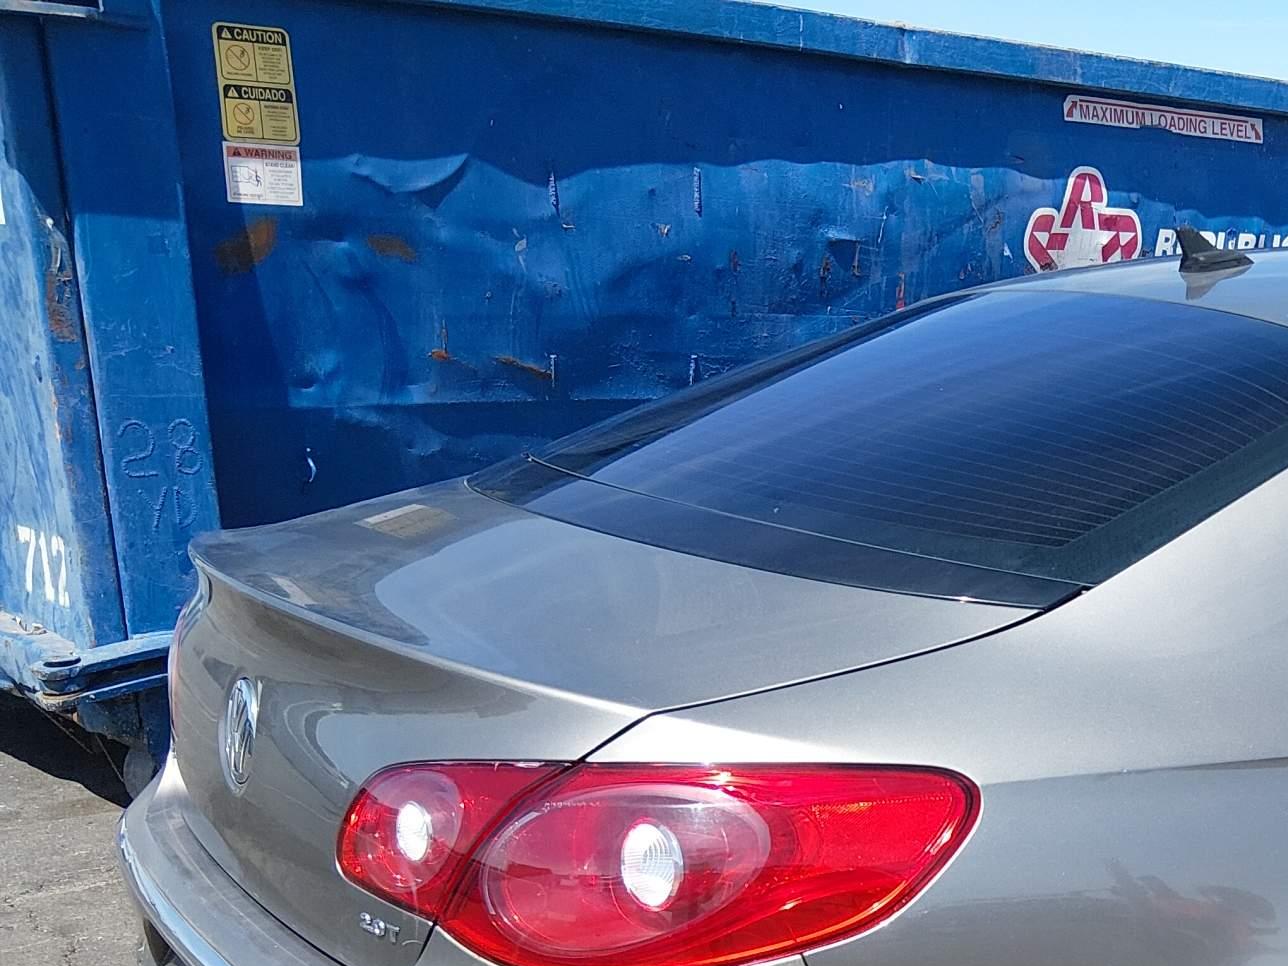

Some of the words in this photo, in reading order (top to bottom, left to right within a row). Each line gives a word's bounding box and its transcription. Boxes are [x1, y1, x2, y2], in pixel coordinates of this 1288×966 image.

[233, 28, 283, 44] CAUTION
[241, 87, 286, 102] CUIDADO
[1079, 103, 1146, 127] MAXIMUM
[1211, 121, 1252, 140] LEVEL
[244, 147, 292, 160] WARNING
[117, 418, 203, 479] 28
[16, 524, 70, 608] 712
